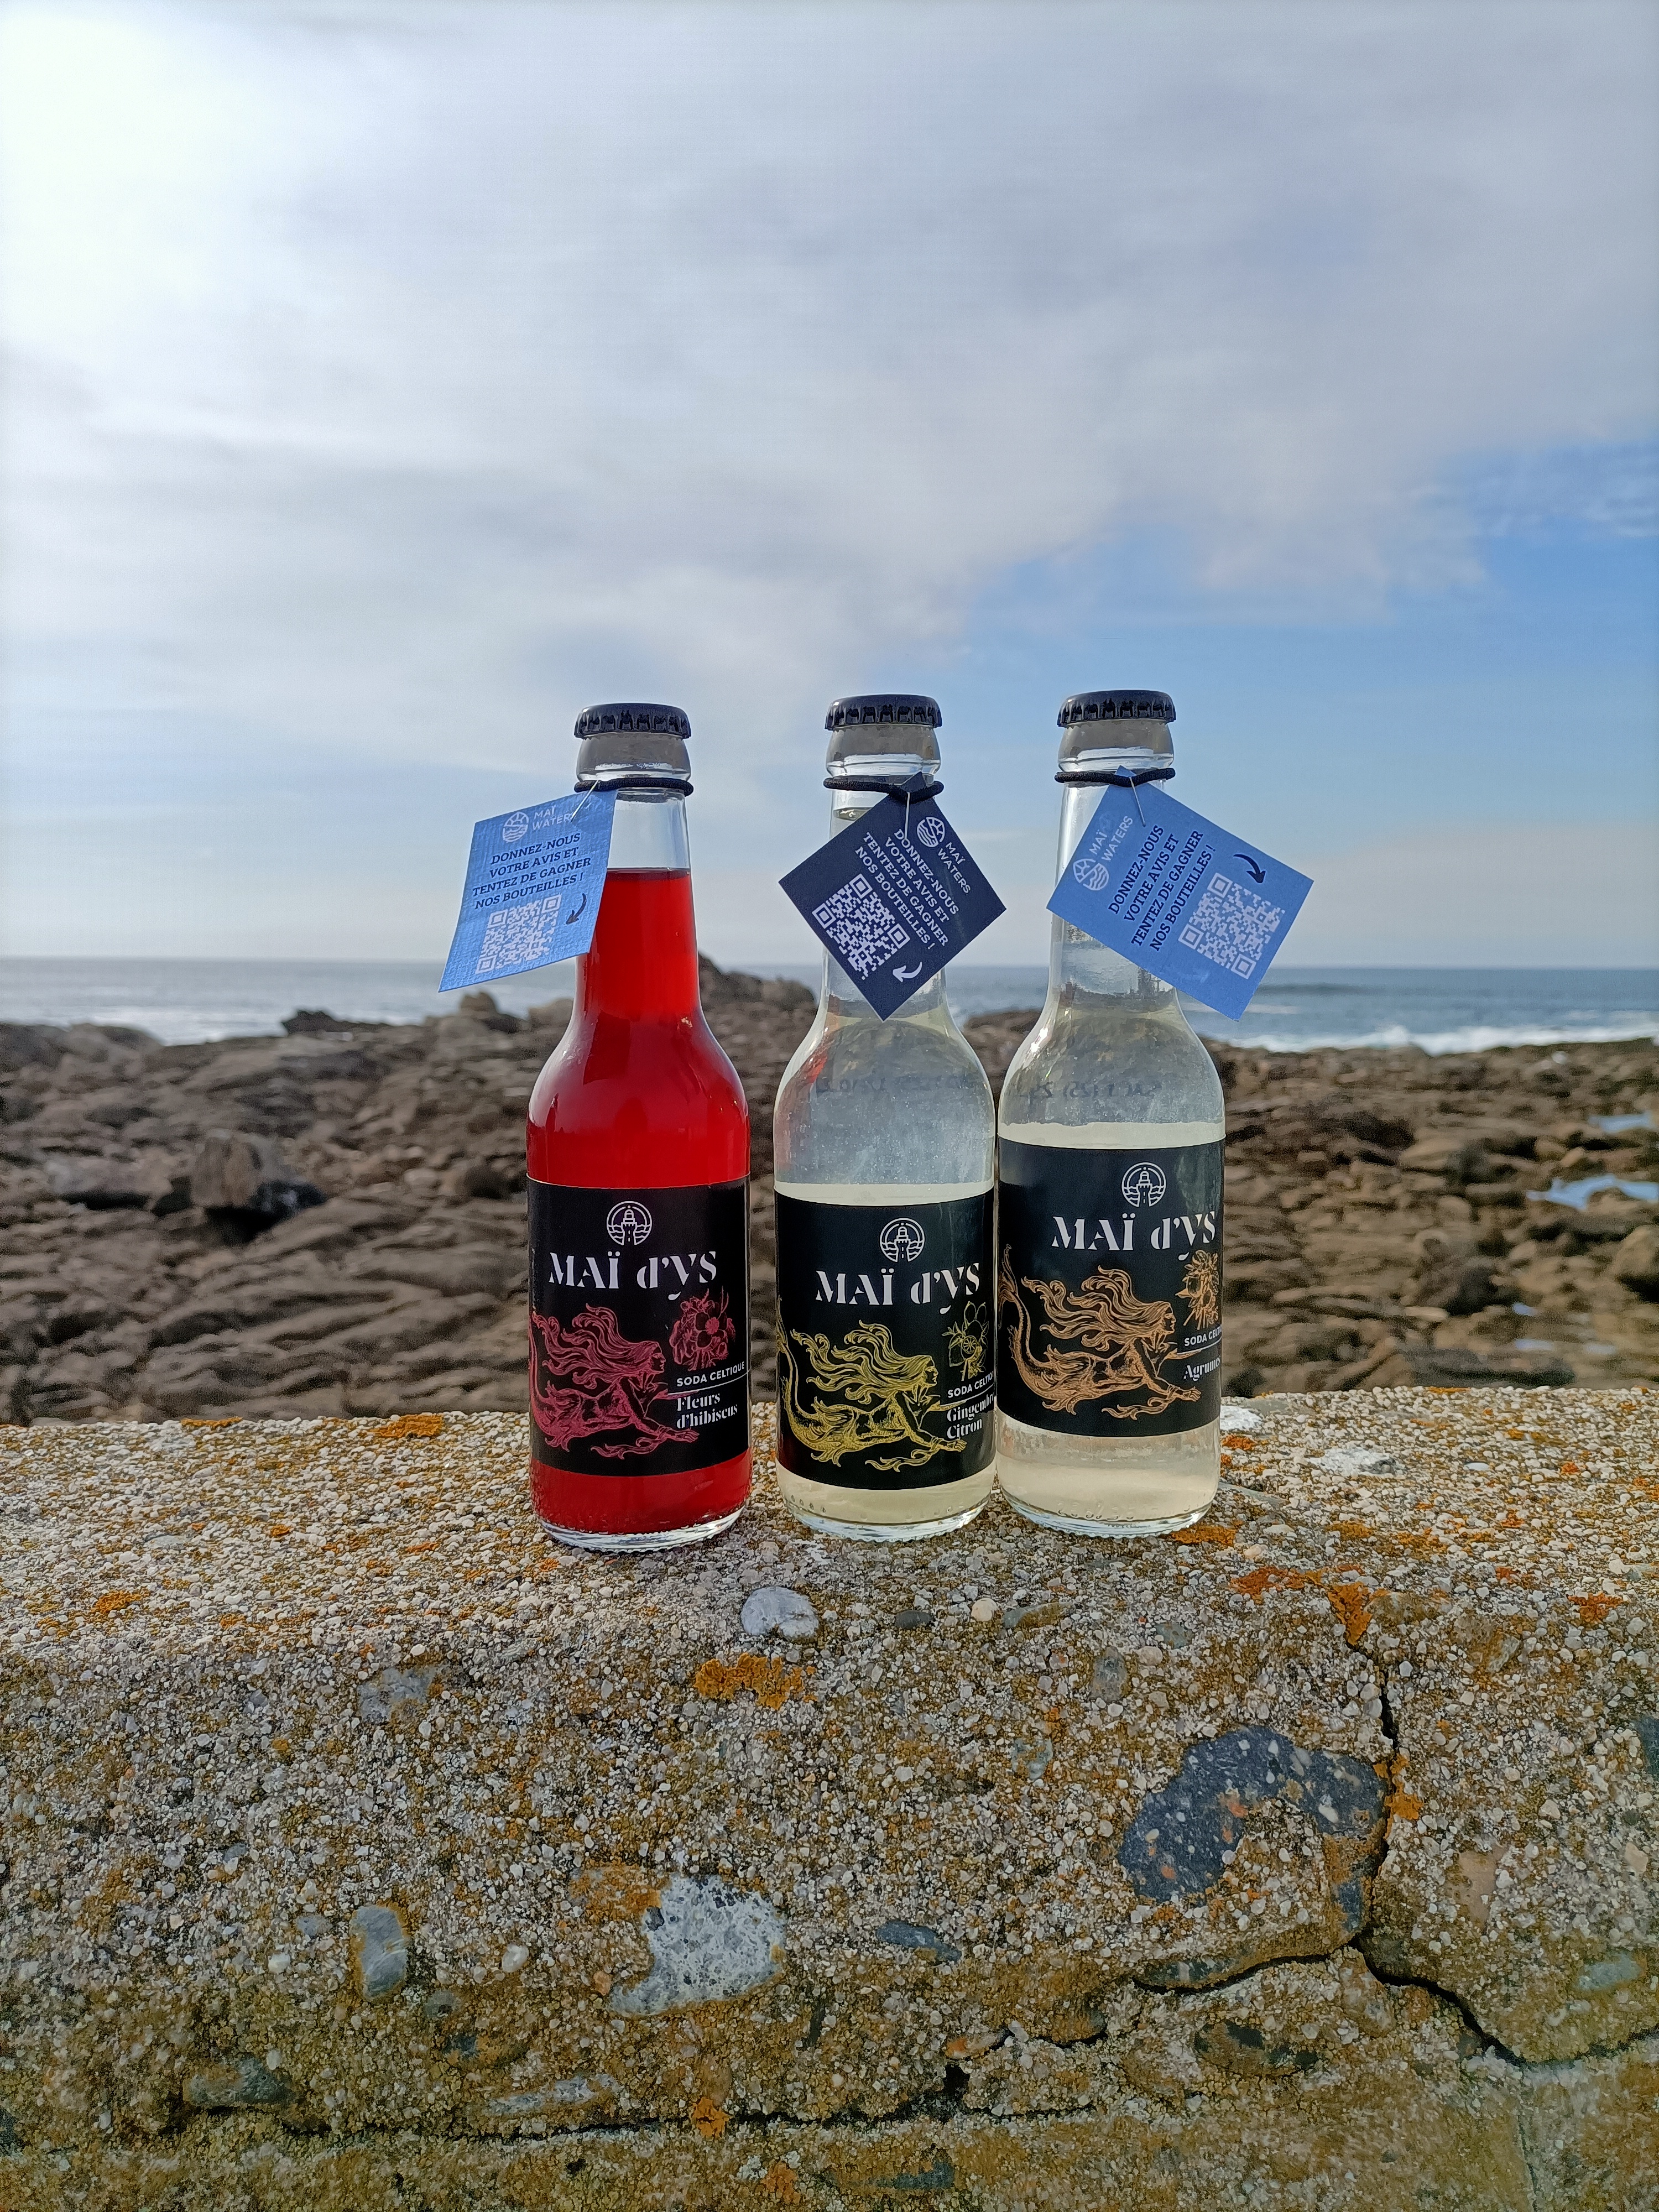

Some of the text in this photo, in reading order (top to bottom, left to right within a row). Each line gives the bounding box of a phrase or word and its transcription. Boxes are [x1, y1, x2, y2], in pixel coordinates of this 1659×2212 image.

[532, 811, 573, 831] WATER
[1101, 816, 1133, 861] WATERS
[491, 833, 581, 865] DONNEZ-NOUS
[945, 842, 966, 864] MAÏ
[1089, 829, 1108, 855] MAÏ
[472, 857, 591, 896] TENTEZ DE GAGNER
[489, 847, 580, 878] VOTRE AVIS ET
[885, 837, 950, 923] VOTRE AVIS ET
[894, 828, 959, 915] DONNEZ-NOUS
[938, 848, 971, 894] WATERS
[1108, 825, 1164, 915] DONNEZ-NOUS
[1123, 833, 1179, 921] VOTRE AVIS ET
[474, 895, 500, 910] NOS
[502, 874, 577, 902] BOUTEILLES
[855, 846, 878, 874] NOS
[874, 872, 931, 943] BOUTEILLES
[863, 832, 948, 947] TENTEZ DE GAGNER
[1130, 831, 1204, 946] TENTEZ DE GAGNER
[1149, 922, 1171, 952] NOS
[1164, 850, 1212, 925] BOUTEILLES
[1051, 1213, 1136, 1251] MAÏ
[549, 1251, 620, 1289] MAÏ
[815, 1268, 894, 1306] MAÏ
[1184, 1324, 1222, 1347] SODA CELT
[676, 1361, 745, 1387] SODA CELTIQUE
[947, 1371, 994, 1399] SODA CELTIQ
[1183, 1355, 1221, 1381] Agrume
[676, 1404, 738, 1429] d'hibiscus
[677, 1393, 721, 1411] Fleurs
[947, 1394, 994, 1421] Gingembr
[947, 1418, 982, 1439] Citron
